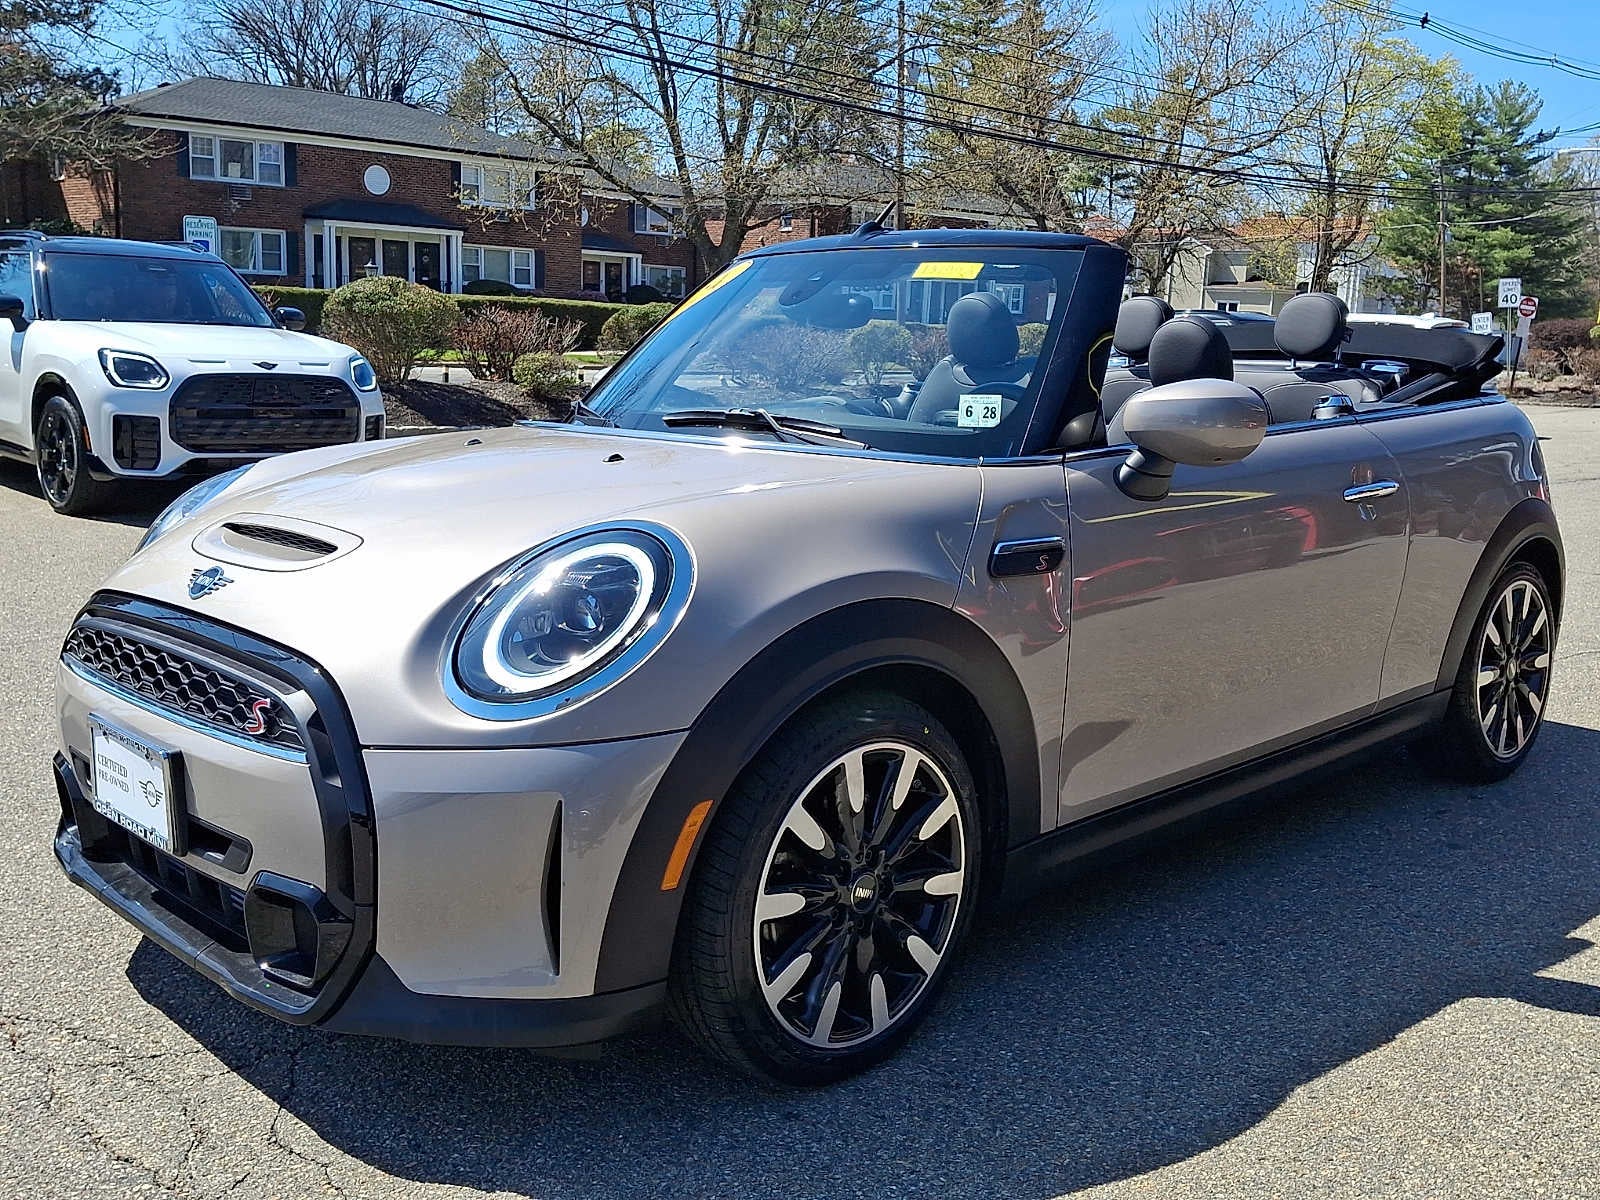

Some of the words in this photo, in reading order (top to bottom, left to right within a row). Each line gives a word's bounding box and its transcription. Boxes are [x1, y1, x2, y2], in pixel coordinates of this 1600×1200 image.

[188, 229, 214, 239] PARKING
[1501, 293, 1518, 305] 40
[965, 405, 973, 418] 6
[982, 406, 997, 419] 28
[1035, 554, 1049, 571] S
[245, 697, 271, 735] S
[97, 752, 128, 779] CERTIFIED
[98, 767, 130, 793] PRE-OWNED
[120, 815, 147, 836] ROAD
